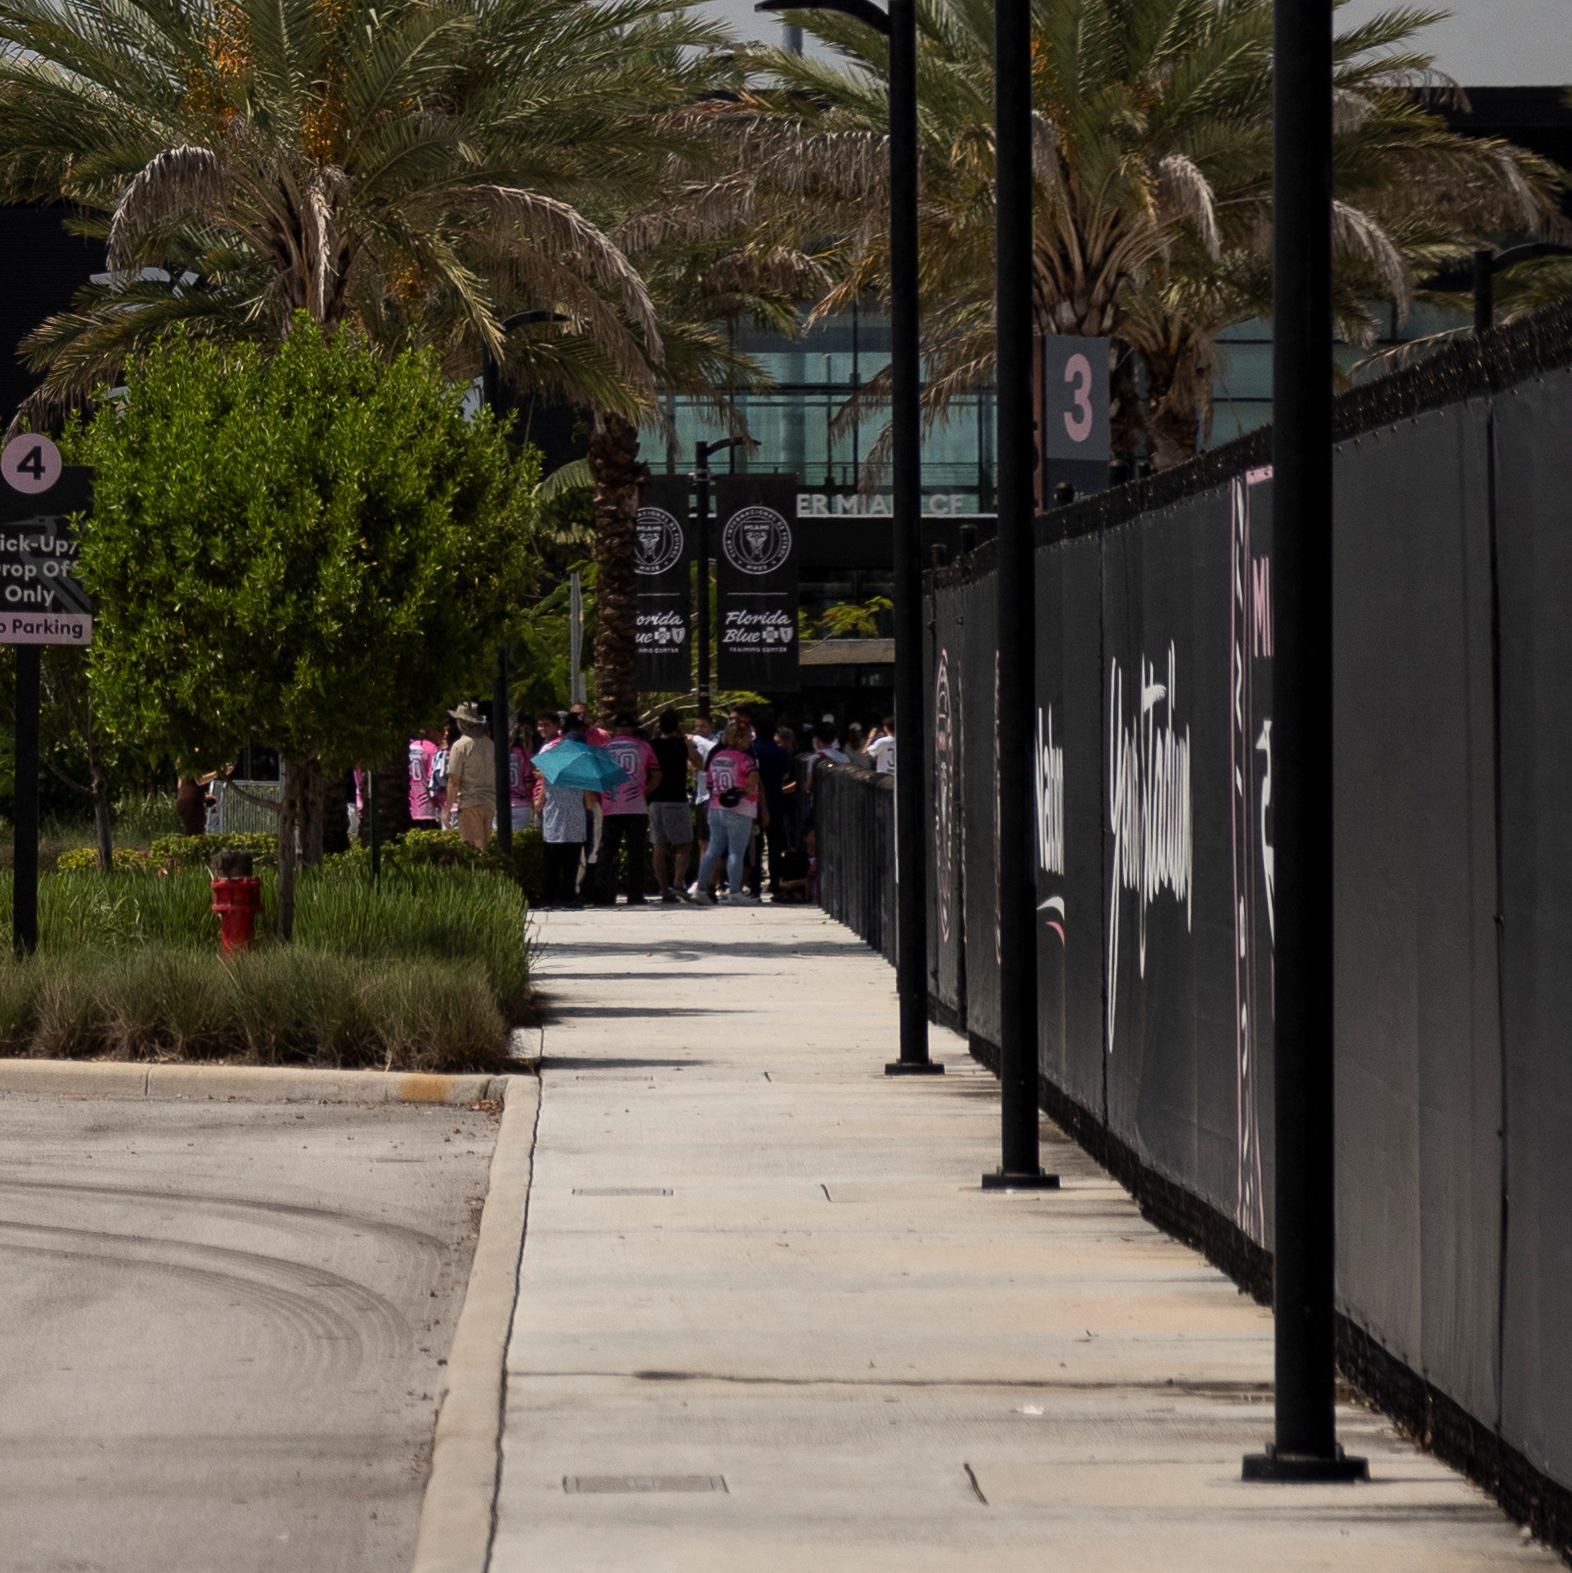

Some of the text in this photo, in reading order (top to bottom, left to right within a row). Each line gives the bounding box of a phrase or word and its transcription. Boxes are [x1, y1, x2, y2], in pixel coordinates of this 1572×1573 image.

[1063, 353, 1093, 443] 3
[17, 445, 45, 481] 4
[928, 493, 964, 515] CF
[5, 585, 55, 606] Only
[725, 609, 793, 625] Florida
[12, 618, 84, 639] Parking
[723, 628, 761, 643] Blue
